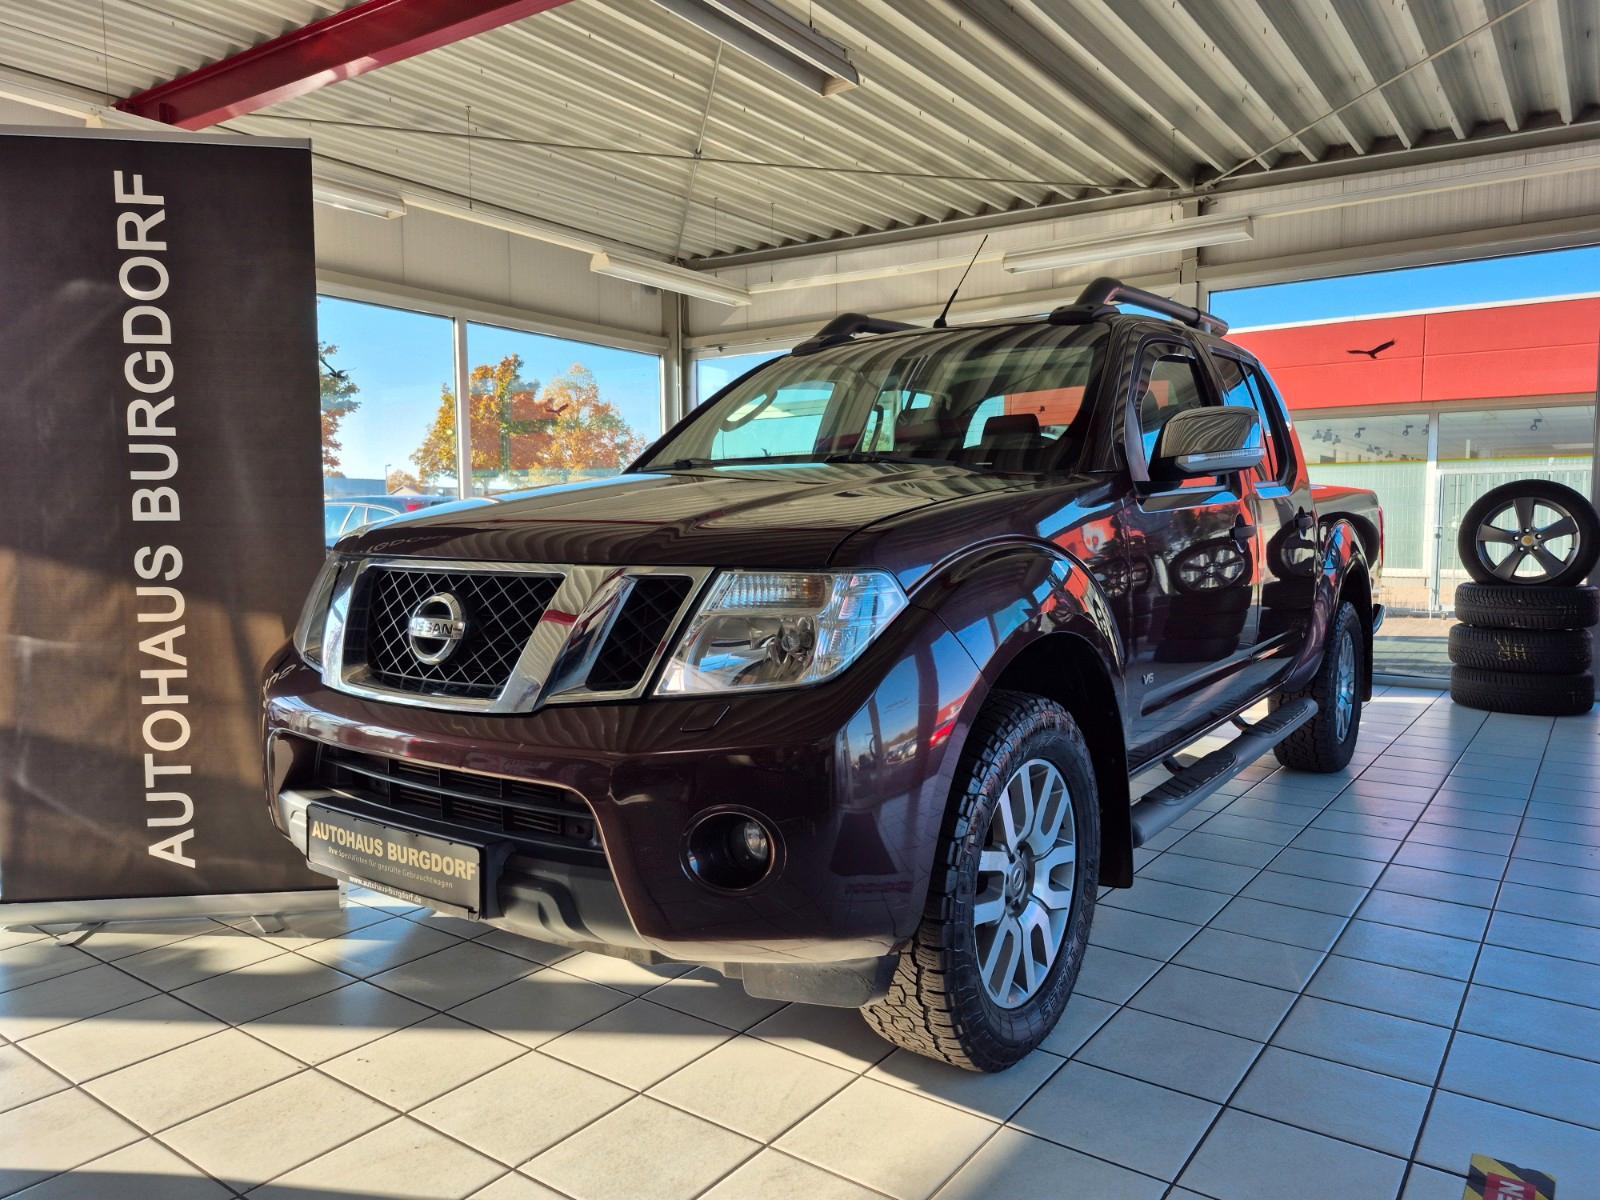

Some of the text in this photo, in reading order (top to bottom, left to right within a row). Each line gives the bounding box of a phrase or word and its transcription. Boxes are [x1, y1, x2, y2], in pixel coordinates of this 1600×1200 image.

[113, 170, 196, 868] AUTOHAUS BURGDORF
[311, 820, 477, 881] AUTOHAUS BURGDORF
